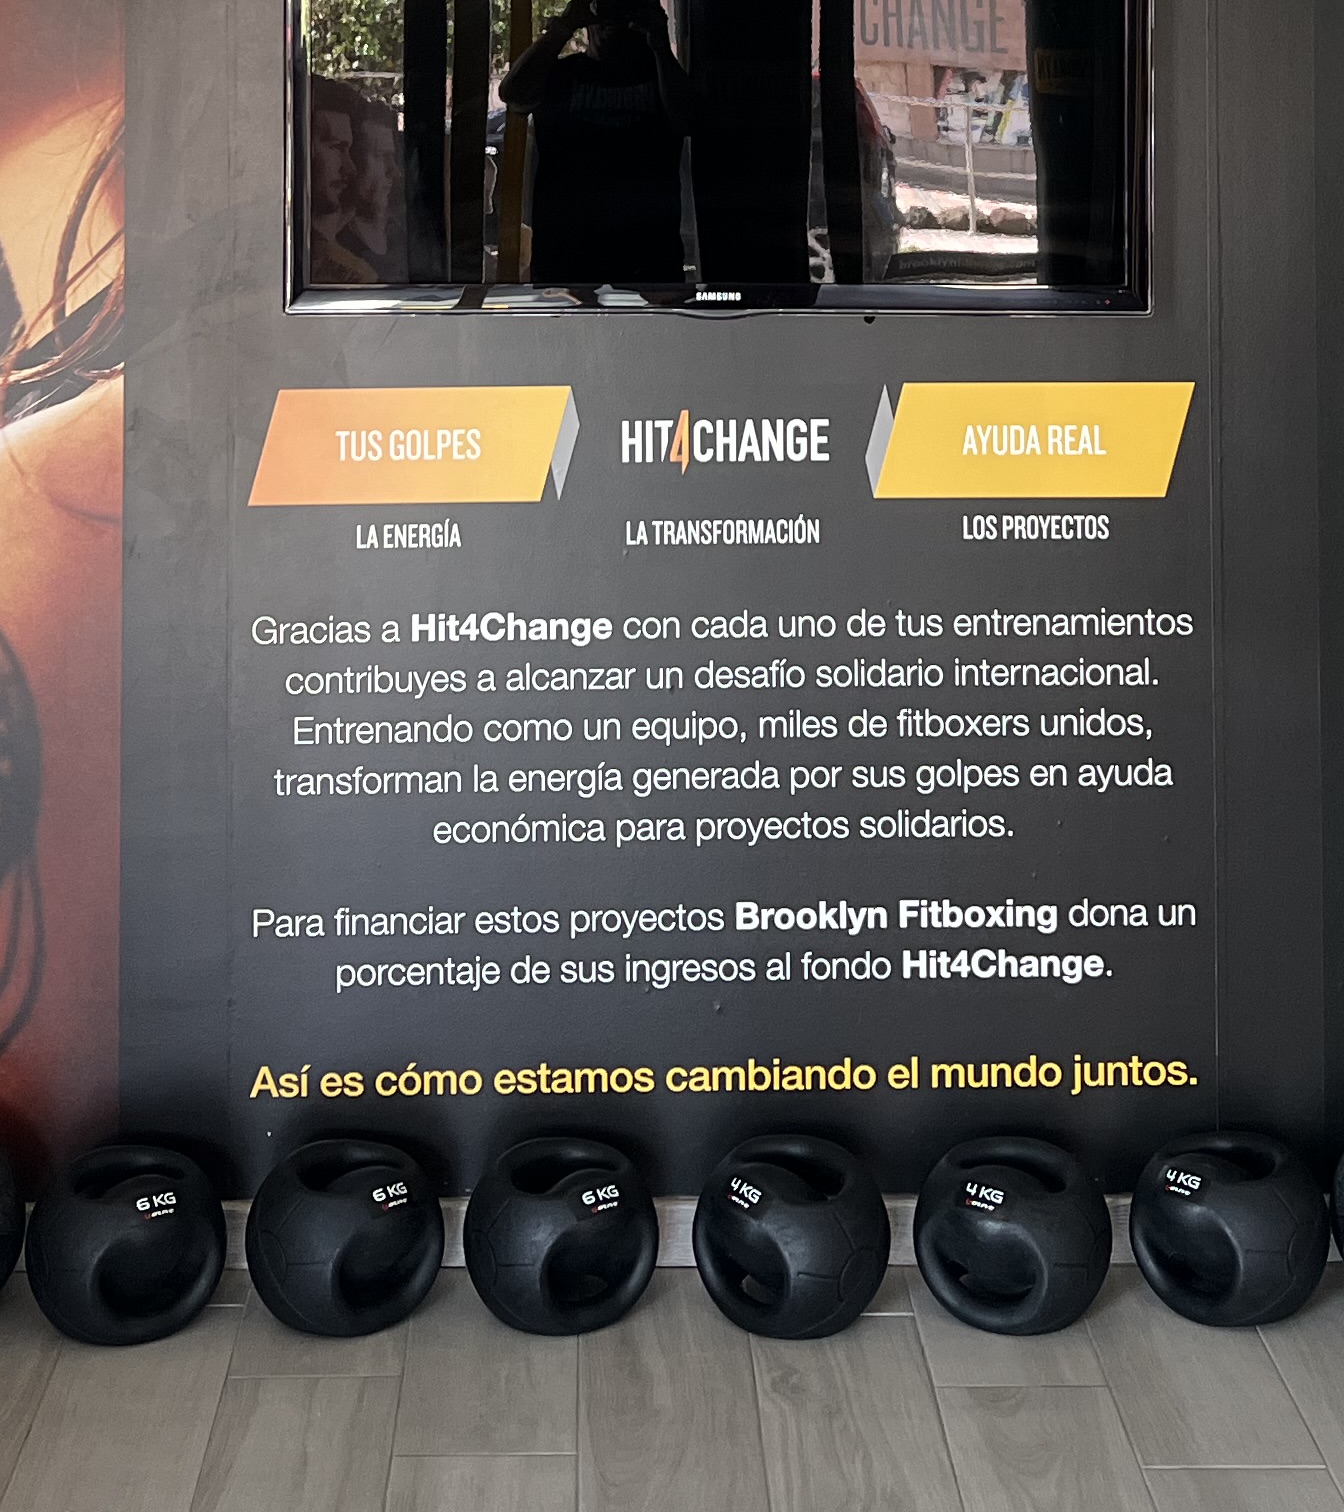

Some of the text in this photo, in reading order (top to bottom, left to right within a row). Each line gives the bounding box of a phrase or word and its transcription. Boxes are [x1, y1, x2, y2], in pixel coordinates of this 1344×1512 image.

[696, 291, 741, 301] SAMSUNG
[335, 428, 481, 461] TUS GOLPES
[621, 409, 830, 475] HIT4CHANGE
[962, 424, 1107, 456] AYUDA REAL
[356, 517, 462, 549] LA ENERGÍA
[625, 513, 820, 546] LA TRANSFORMACIÓN
[962, 514, 1110, 540] LOS PROYECTOS
[251, 607, 1194, 647] Gracias a Hit4Change con cada uno de tus entrenamientos
[285, 656, 1159, 700] contribuyes a alcanzar un desafío solidario internacional.
[293, 707, 1152, 747] Entrenando como un equipo, miles de fitboxers unidos,
[273, 757, 1174, 799] transforman la energía generada por sus golpes en ayuda
[433, 808, 1014, 848] económica para proyectos solidarios.
[253, 897, 1196, 940] Para financiar estos proyectos Brooklyn Fitboxing dona un
[336, 948, 1113, 994] porcentaje de sus ingresos al fondo Hit4Change.
[249, 1054, 1198, 1098] Así es cómo estamos cambiando el mundo juntos.
[387, 1182, 408, 1198] KG
[596, 1184, 620, 1201] KG
[739, 1182, 762, 1204] KG
[978, 1186, 1005, 1204] KG
[1176, 1172, 1202, 1190] KG
[152, 1192, 177, 1207] KG
